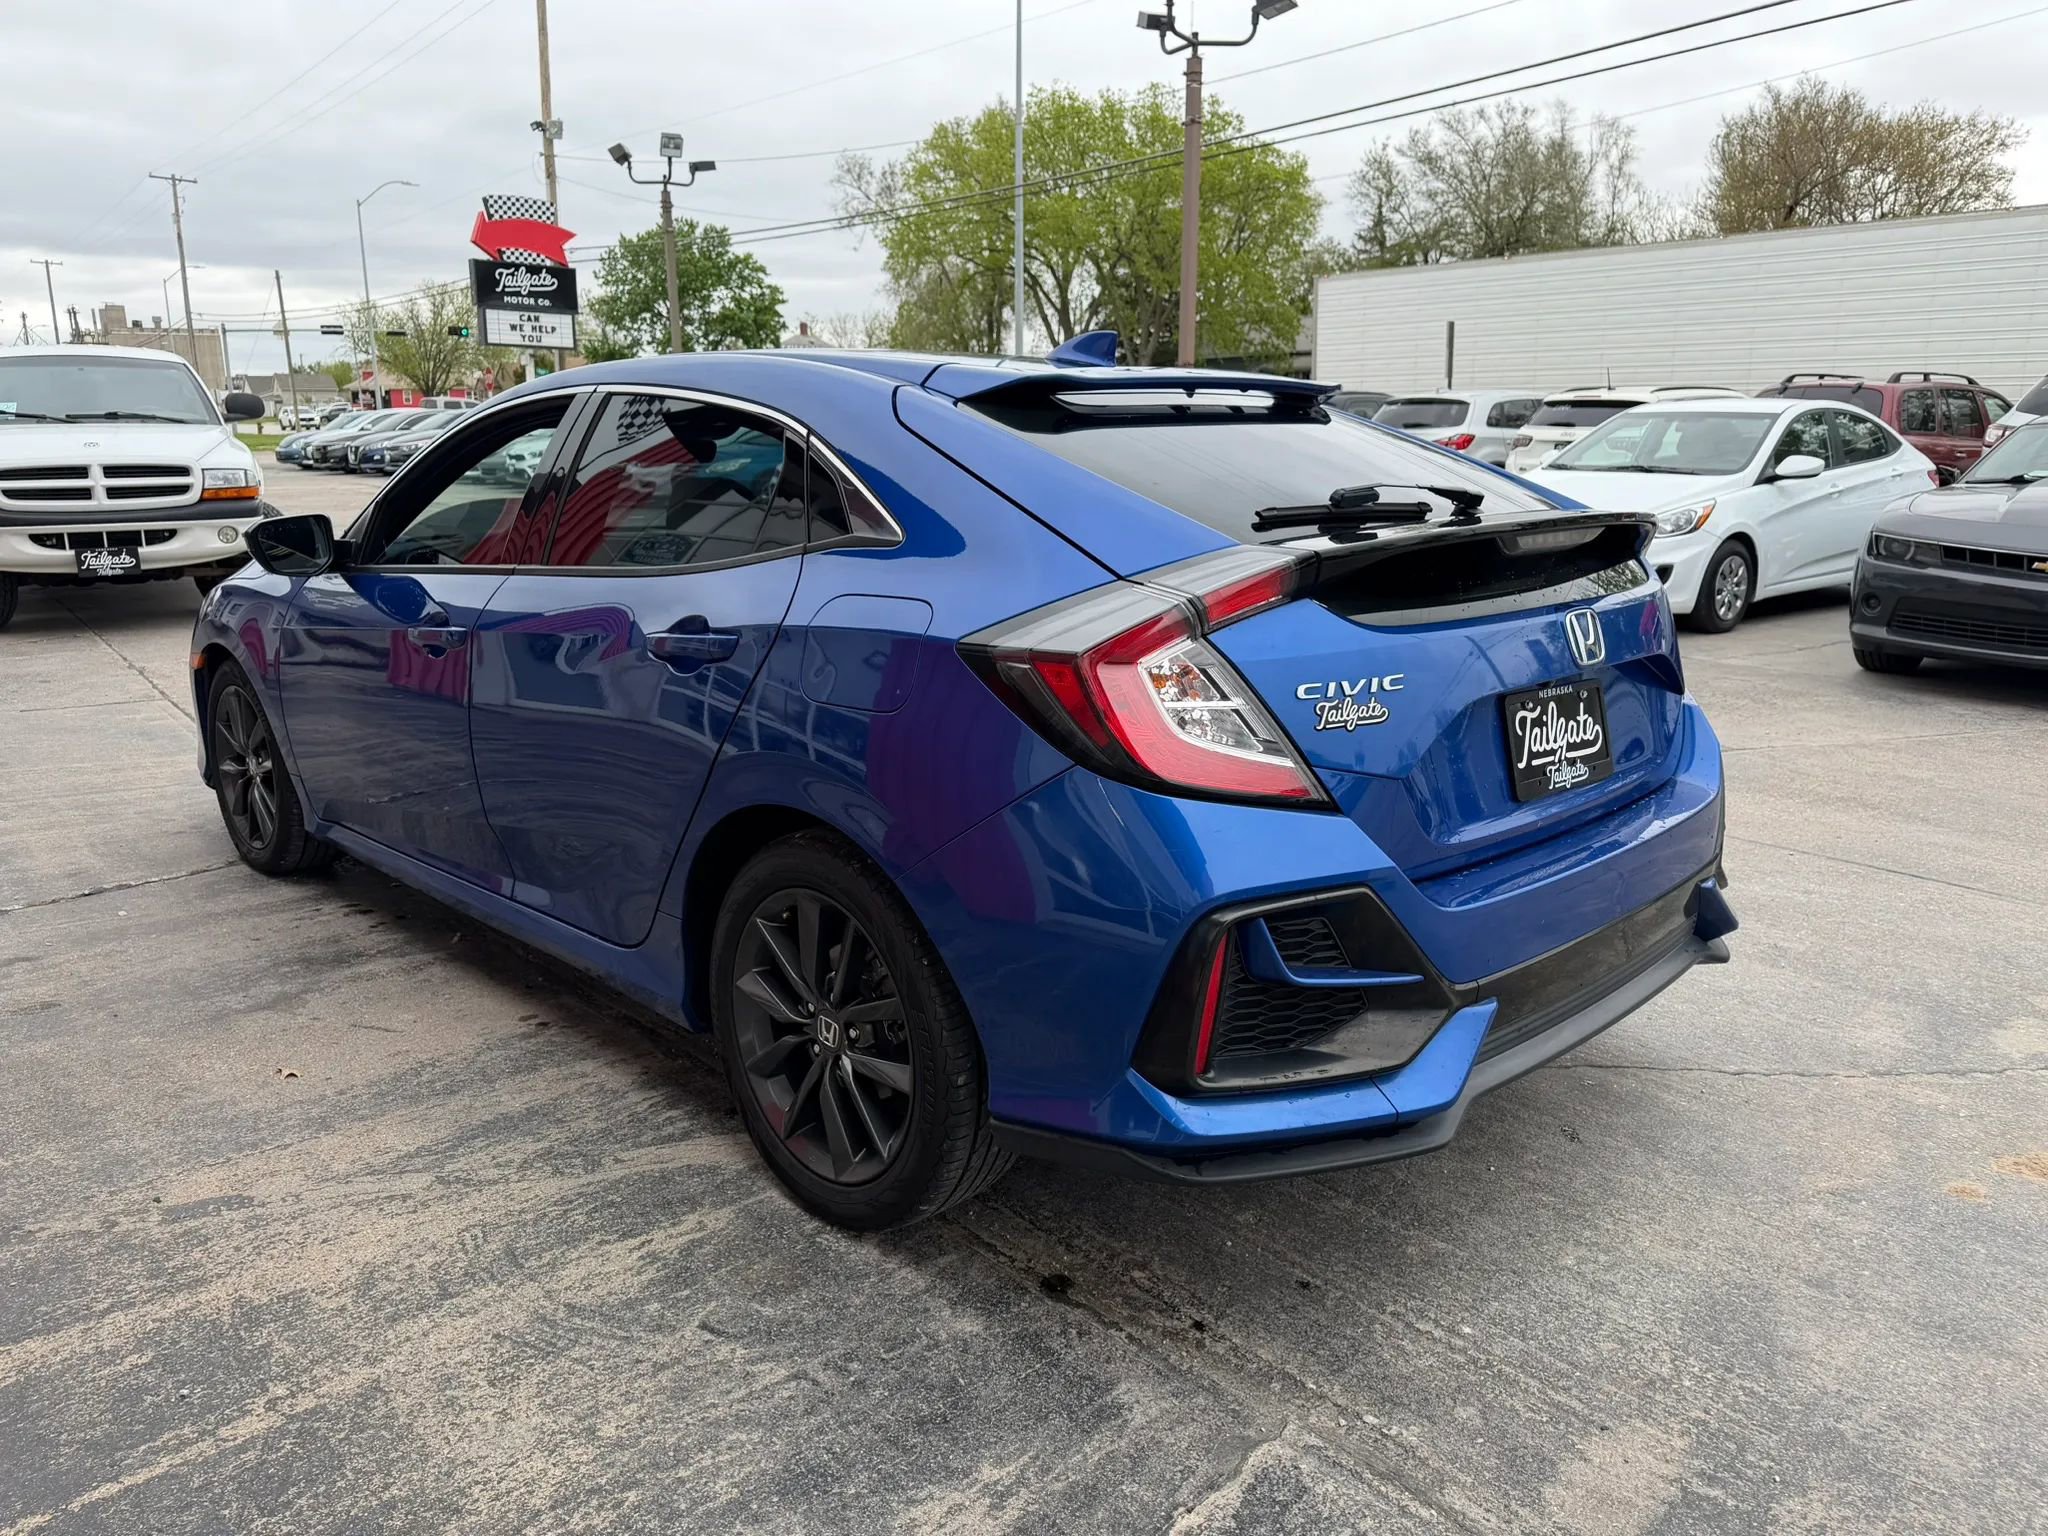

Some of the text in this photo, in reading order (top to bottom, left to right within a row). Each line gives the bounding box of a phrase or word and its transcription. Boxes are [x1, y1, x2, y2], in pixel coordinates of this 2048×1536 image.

[495, 266, 558, 295] Tailgate
[504, 296, 535, 306] MOTOR
[519, 314, 540, 323] CAN
[509, 323, 557, 334] WE HELP
[520, 334, 542, 343] YOU
[81, 550, 136, 569] Tailgate
[1296, 674, 1404, 699] CIVIC
[1538, 685, 1573, 699] NEBRASKA
[1315, 697, 1388, 730] Tailgate
[1515, 701, 1602, 769] Tailgate
[1546, 759, 1589, 789] Tailgate
